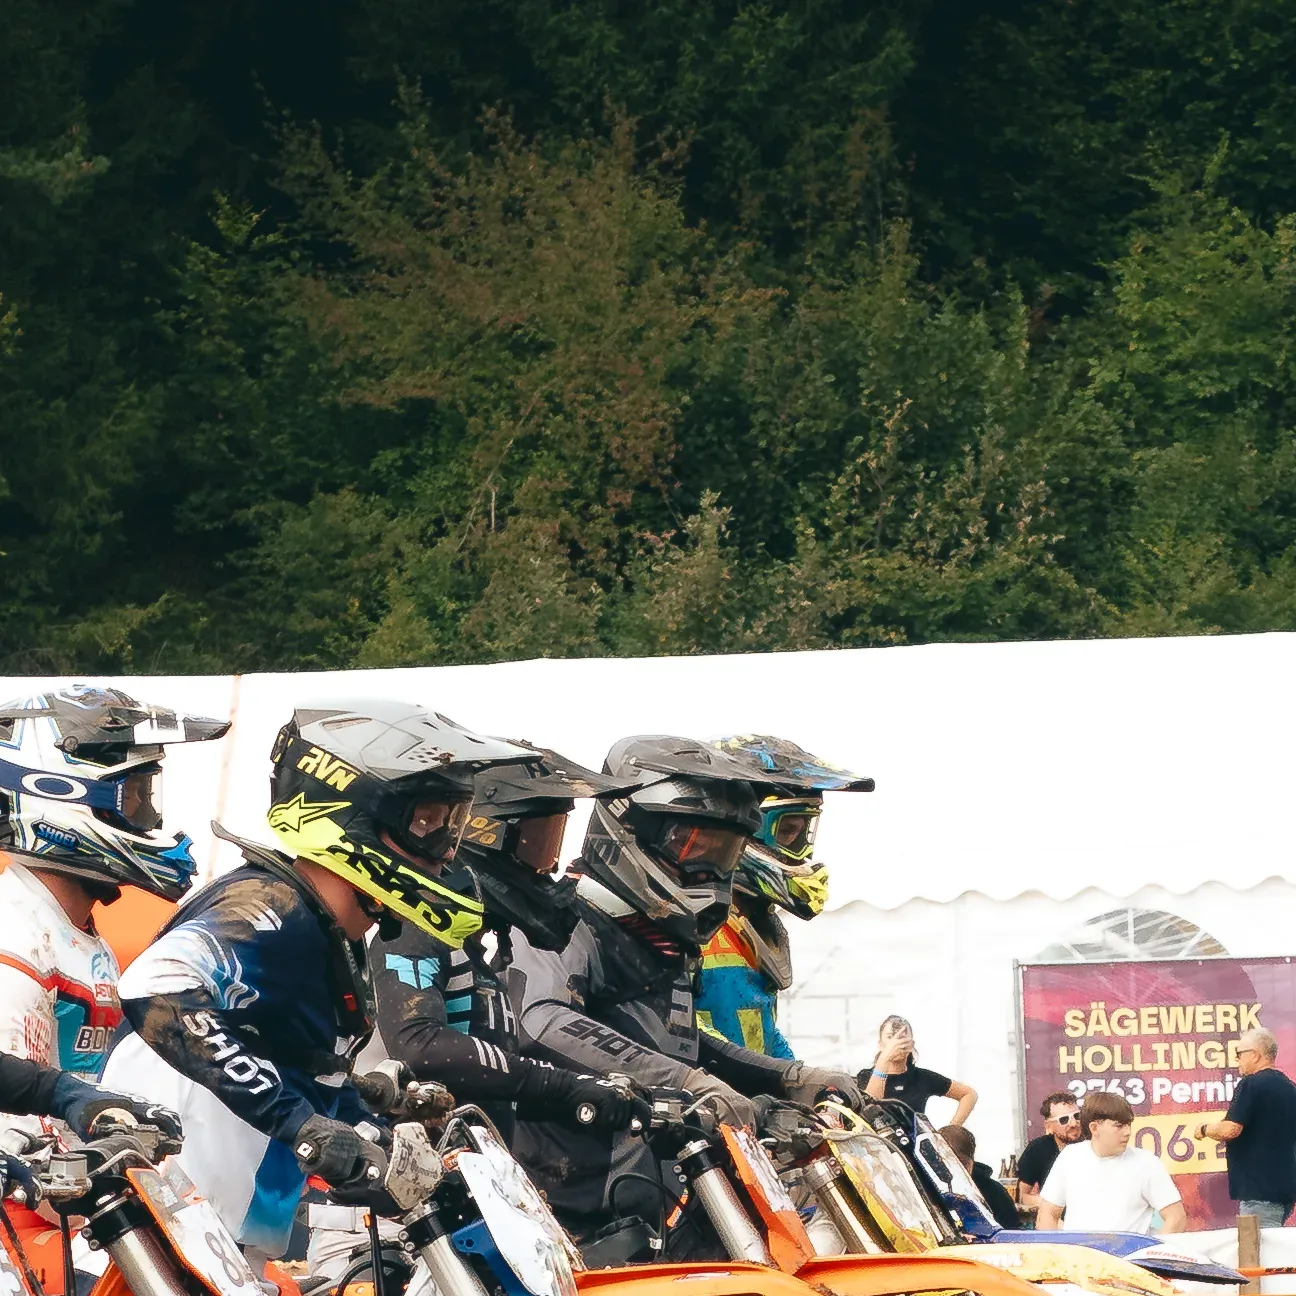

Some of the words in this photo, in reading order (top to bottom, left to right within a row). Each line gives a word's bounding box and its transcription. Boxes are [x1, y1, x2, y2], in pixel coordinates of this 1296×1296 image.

[297, 746, 360, 792] RVN
[558, 1017, 645, 1064] SHOT
[1064, 1002, 1262, 1038] SÄGEWERK
[182, 1011, 274, 1095] SHOT
[1059, 1040, 1241, 1074] HOLLINGE
[1152, 1075, 1242, 1104] Perni
